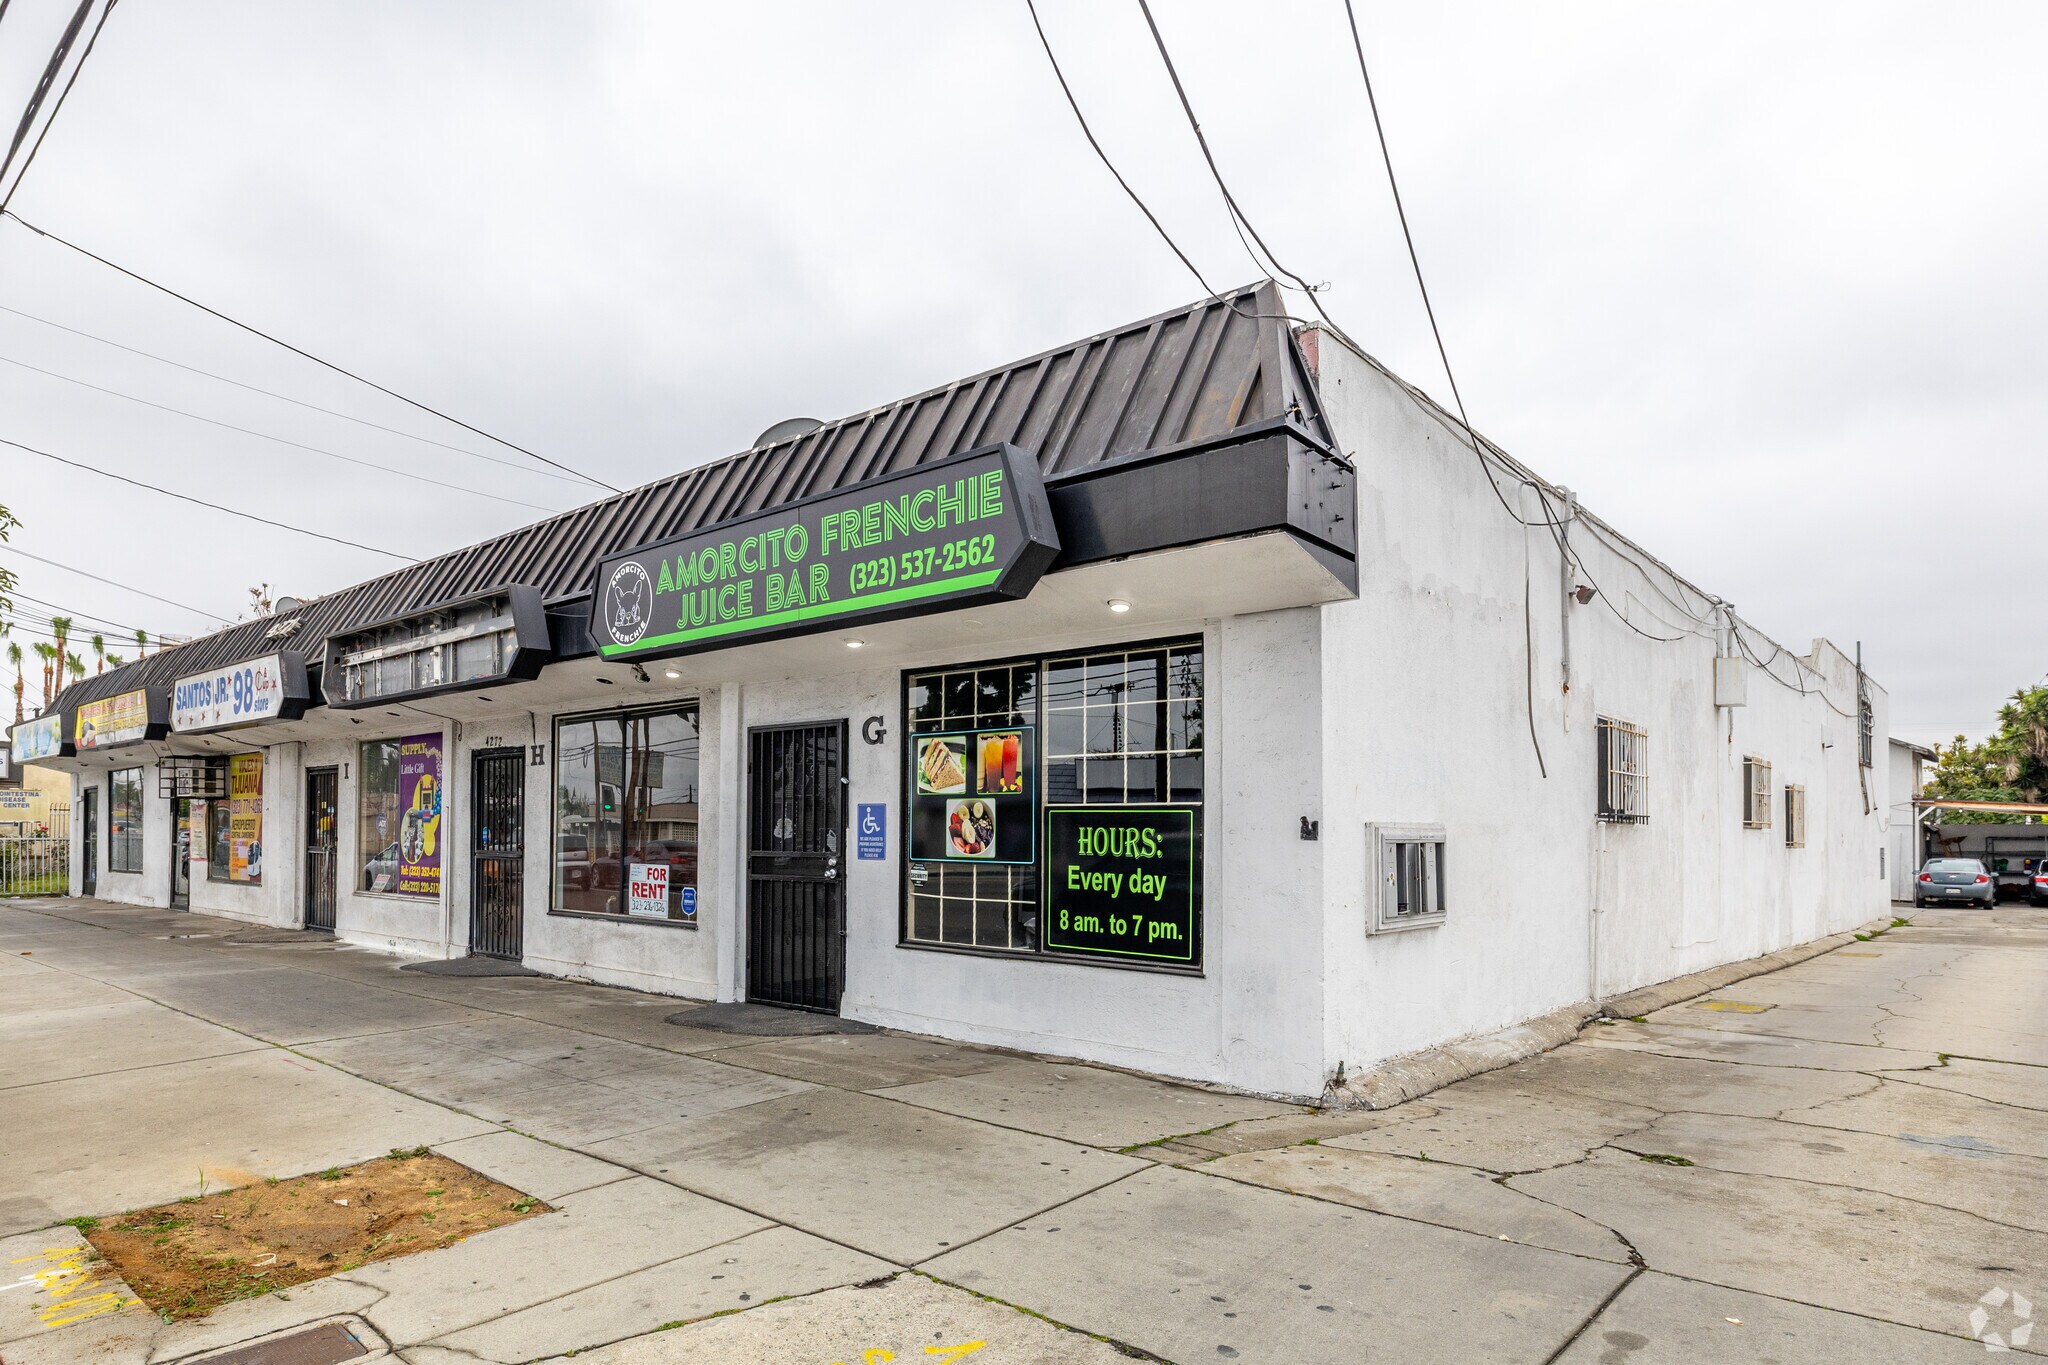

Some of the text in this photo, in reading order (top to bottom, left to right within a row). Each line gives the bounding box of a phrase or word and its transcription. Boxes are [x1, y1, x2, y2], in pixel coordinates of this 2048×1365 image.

[656, 469, 1003, 595] AMORCITO FRENCHIE
[850, 533, 995, 594] (323) 537-2562
[612, 566, 645, 588] AMORCITO
[676, 563, 829, 628] JUICE BAR
[612, 621, 646, 642] FRENCHIE
[176, 668, 253, 715] SANTOS JR. 98
[254, 697, 269, 712] store
[862, 715, 887, 745] G
[401, 742, 427, 756] SUPPLY
[530, 744, 545, 766] H
[231, 773, 258, 794] TIJUANA
[1078, 827, 1163, 859] HOURS:
[647, 867, 667, 881] FOR
[1068, 865, 1167, 901] Every day
[632, 882, 666, 899] RENT
[1060, 909, 1183, 943] 8 am. to 7 pm.
